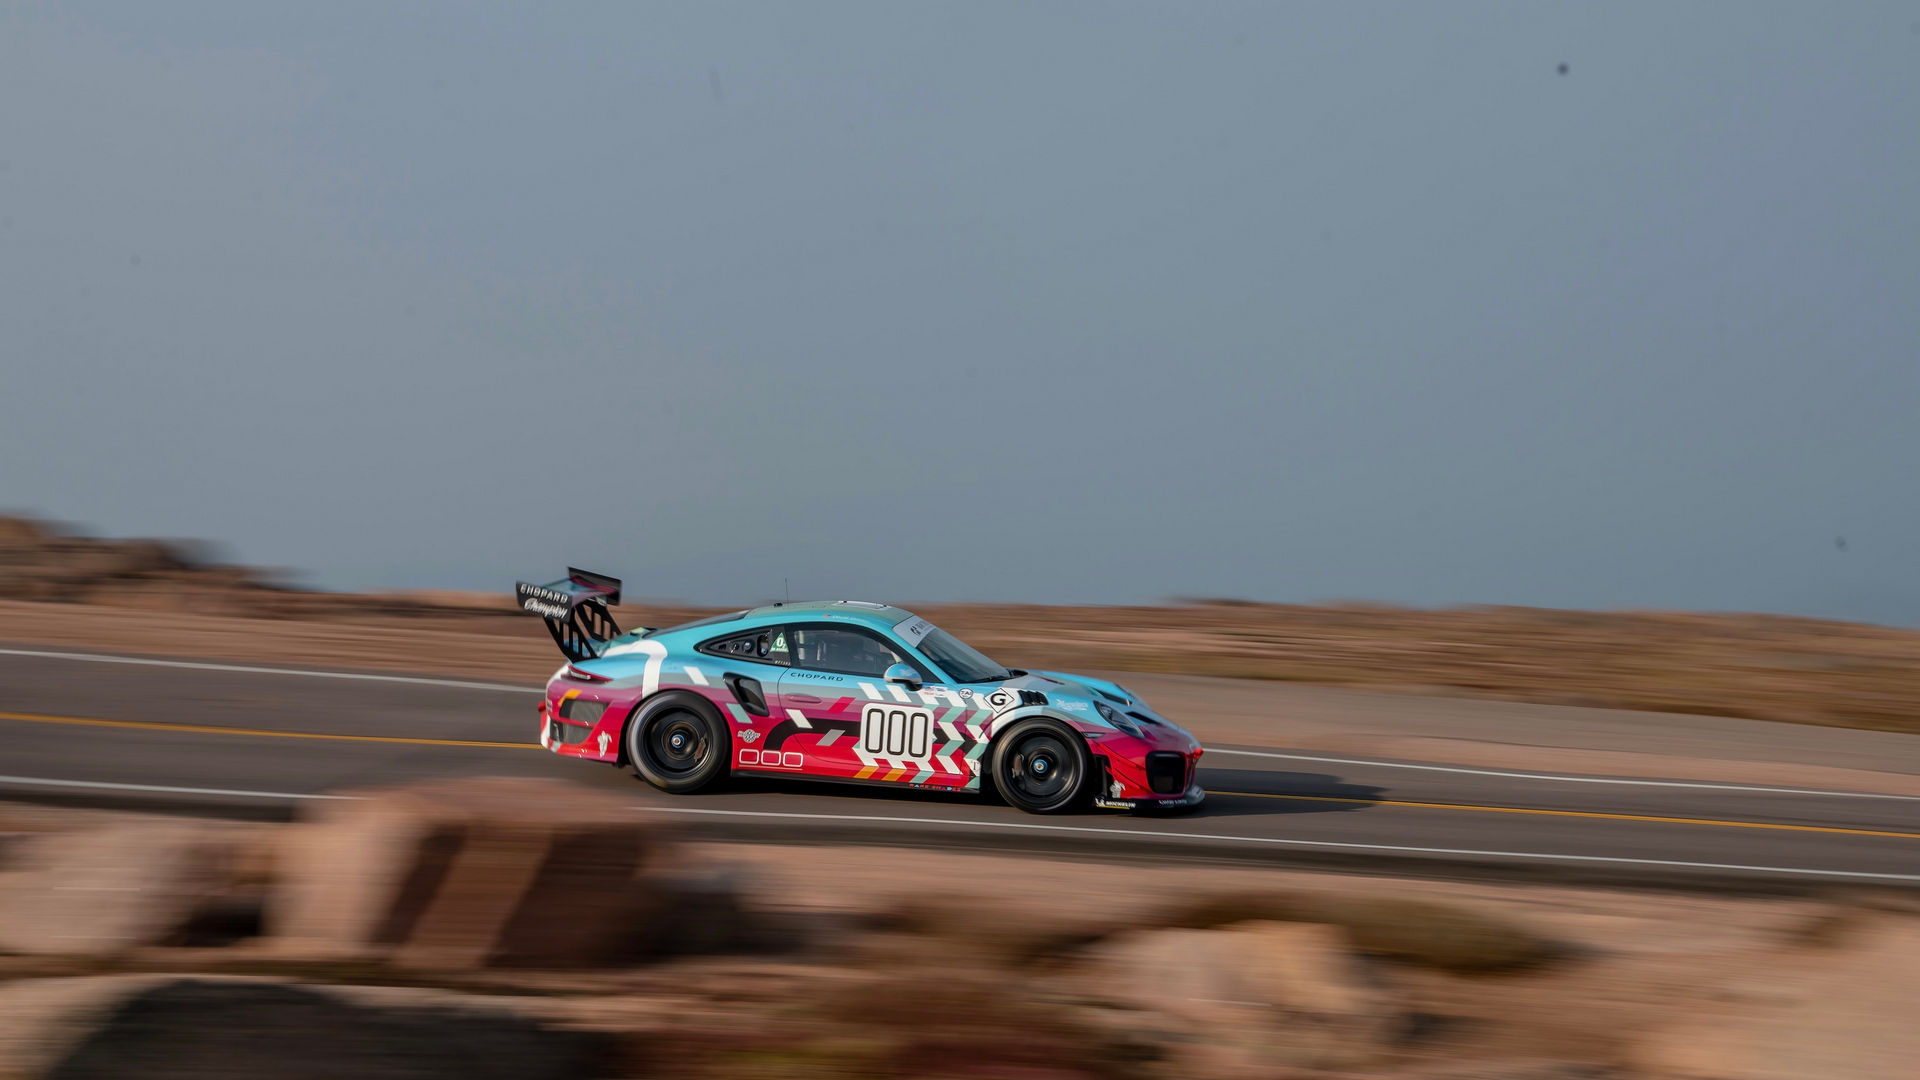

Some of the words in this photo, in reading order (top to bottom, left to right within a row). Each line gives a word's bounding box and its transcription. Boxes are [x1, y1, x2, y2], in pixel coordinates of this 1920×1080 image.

[520, 583, 569, 604] CHOPARD
[790, 672, 844, 682] CHOPARD
[990, 692, 1007, 706] G
[865, 708, 929, 759] 000
[1105, 800, 1136, 808] MICHELIN
